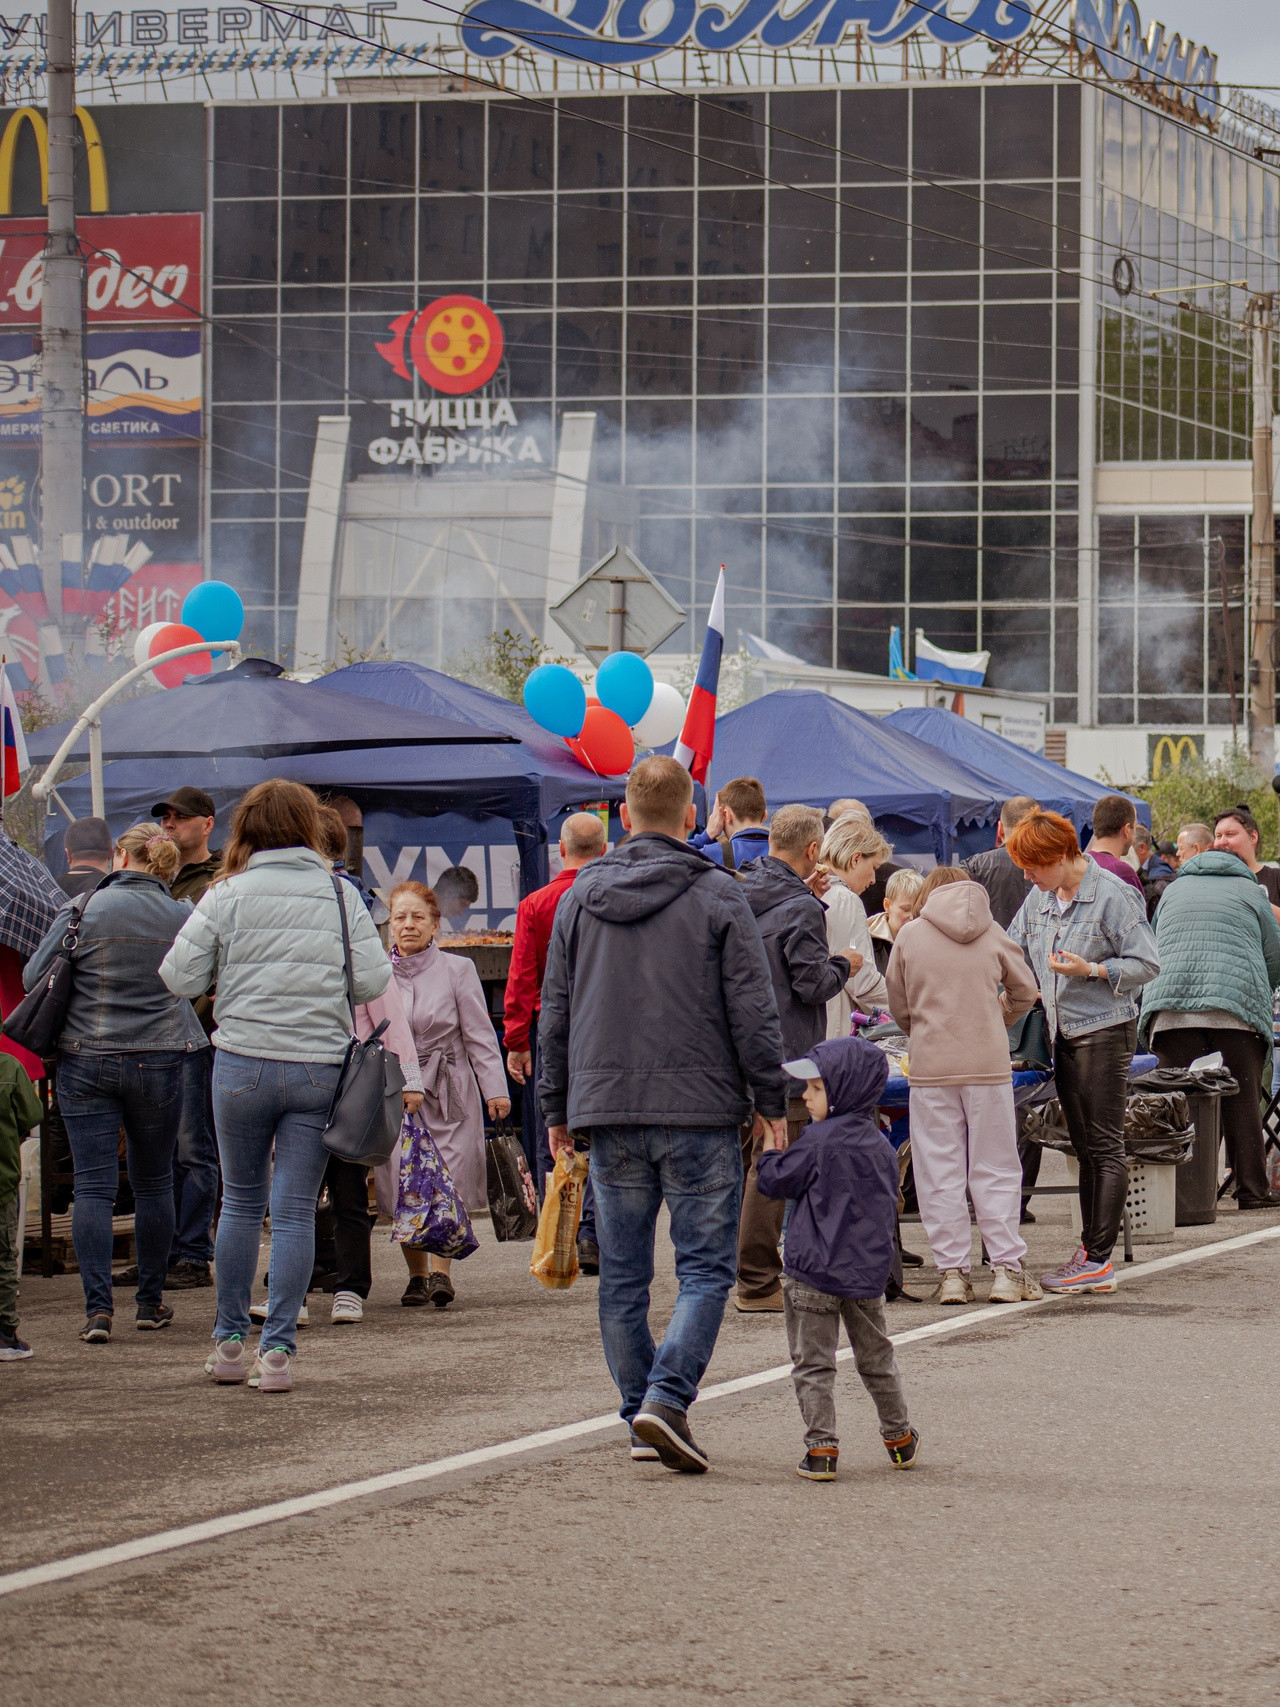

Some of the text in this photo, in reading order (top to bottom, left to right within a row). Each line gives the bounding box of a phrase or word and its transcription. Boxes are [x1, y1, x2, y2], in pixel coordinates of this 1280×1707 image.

[389, 400, 518, 430] ПИЦЦА
[368, 436, 543, 465] ФАБРИКА
[112, 512, 180, 531] outdoor
